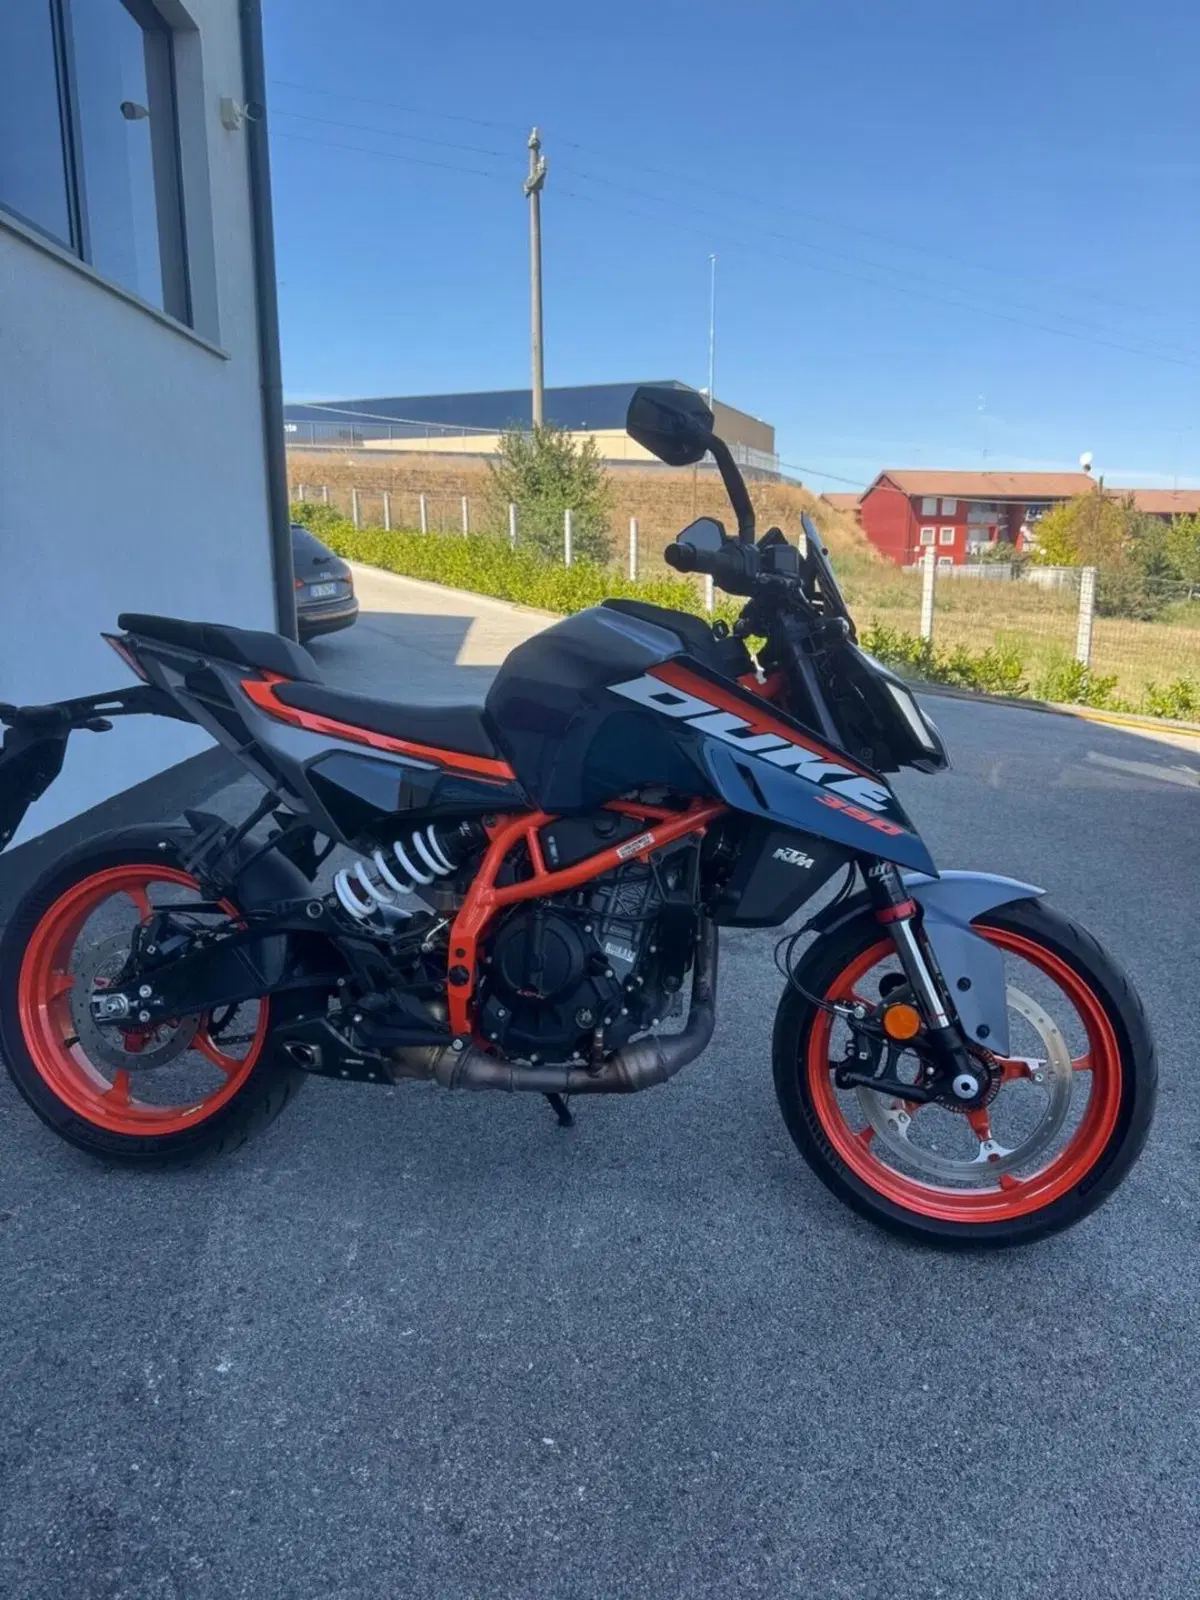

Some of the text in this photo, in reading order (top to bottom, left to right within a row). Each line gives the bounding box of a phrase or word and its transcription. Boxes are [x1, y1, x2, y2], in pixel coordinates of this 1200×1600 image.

[606, 674, 892, 811] DUKE
[814, 795, 904, 835] 390
[772, 847, 815, 868] KTM
